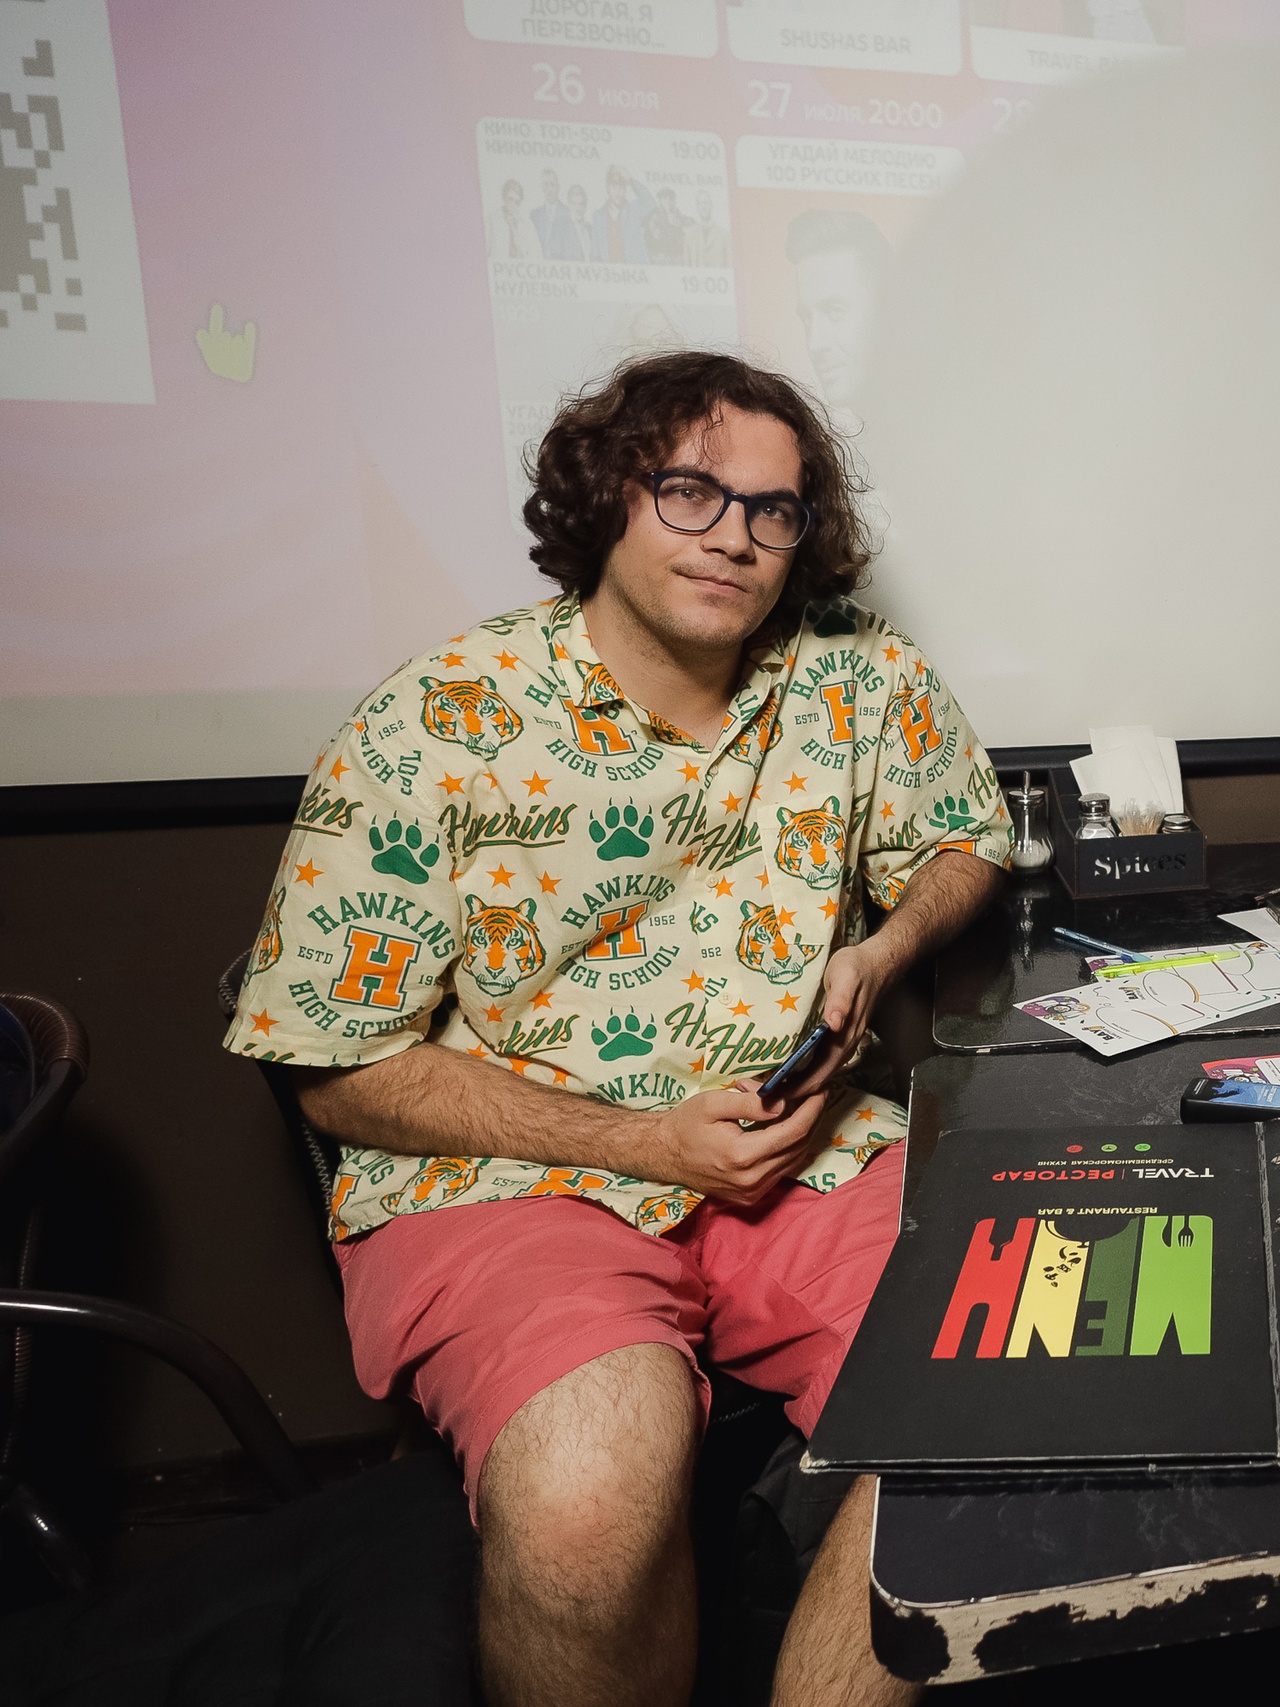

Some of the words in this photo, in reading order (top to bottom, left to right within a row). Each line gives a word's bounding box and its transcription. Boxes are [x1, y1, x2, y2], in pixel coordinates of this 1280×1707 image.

[638, 5, 655, 22] Я
[780, 27, 868, 53] SHUSHAS
[874, 32, 912, 55] BAR
[532, 62, 586, 105] 26
[747, 79, 793, 120] 27
[868, 99, 943, 129] 20:00
[671, 141, 720, 161] 19:00
[768, 140, 840, 165] УГАДАЙ
[844, 146, 937, 170] МЕЛОДИЮ
[765, 165, 796, 183] 100
[801, 167, 881, 188] РУССКИХ
[492, 262, 571, 281] РУССКАЯ
[575, 265, 650, 285] МУЗЫКА
[682, 275, 729, 294] 19:00
[494, 281, 579, 299] НУЛЕВЫХ
[789, 649, 885, 700] HAWKINS
[794, 713, 820, 725] ESTD
[858, 707, 881, 716] 1952
[378, 720, 406, 740] 1952
[545, 738, 598, 778] HIGH
[605, 742, 664, 782] SCHOO
[800, 738, 847, 770] HIGH
[883, 764, 921, 788] HIGH
[927, 726, 958, 784] SCHOOL
[560, 874, 676, 930] HAWKINS
[307, 892, 456, 960] HAWKINS
[649, 914, 676, 927] 1952
[297, 946, 334, 965] ESTD
[701, 947, 722, 958] 952
[609, 945, 680, 991] SCHOOL
[288, 979, 342, 1031] HIGH
[597, 1073, 686, 1101] WKINS
[991, 1169, 1116, 1182] РЕСТОБАР
[1132, 1167, 1215, 1179] TRAVEL
[1077, 1206, 1158, 1215] RESTAURANT
